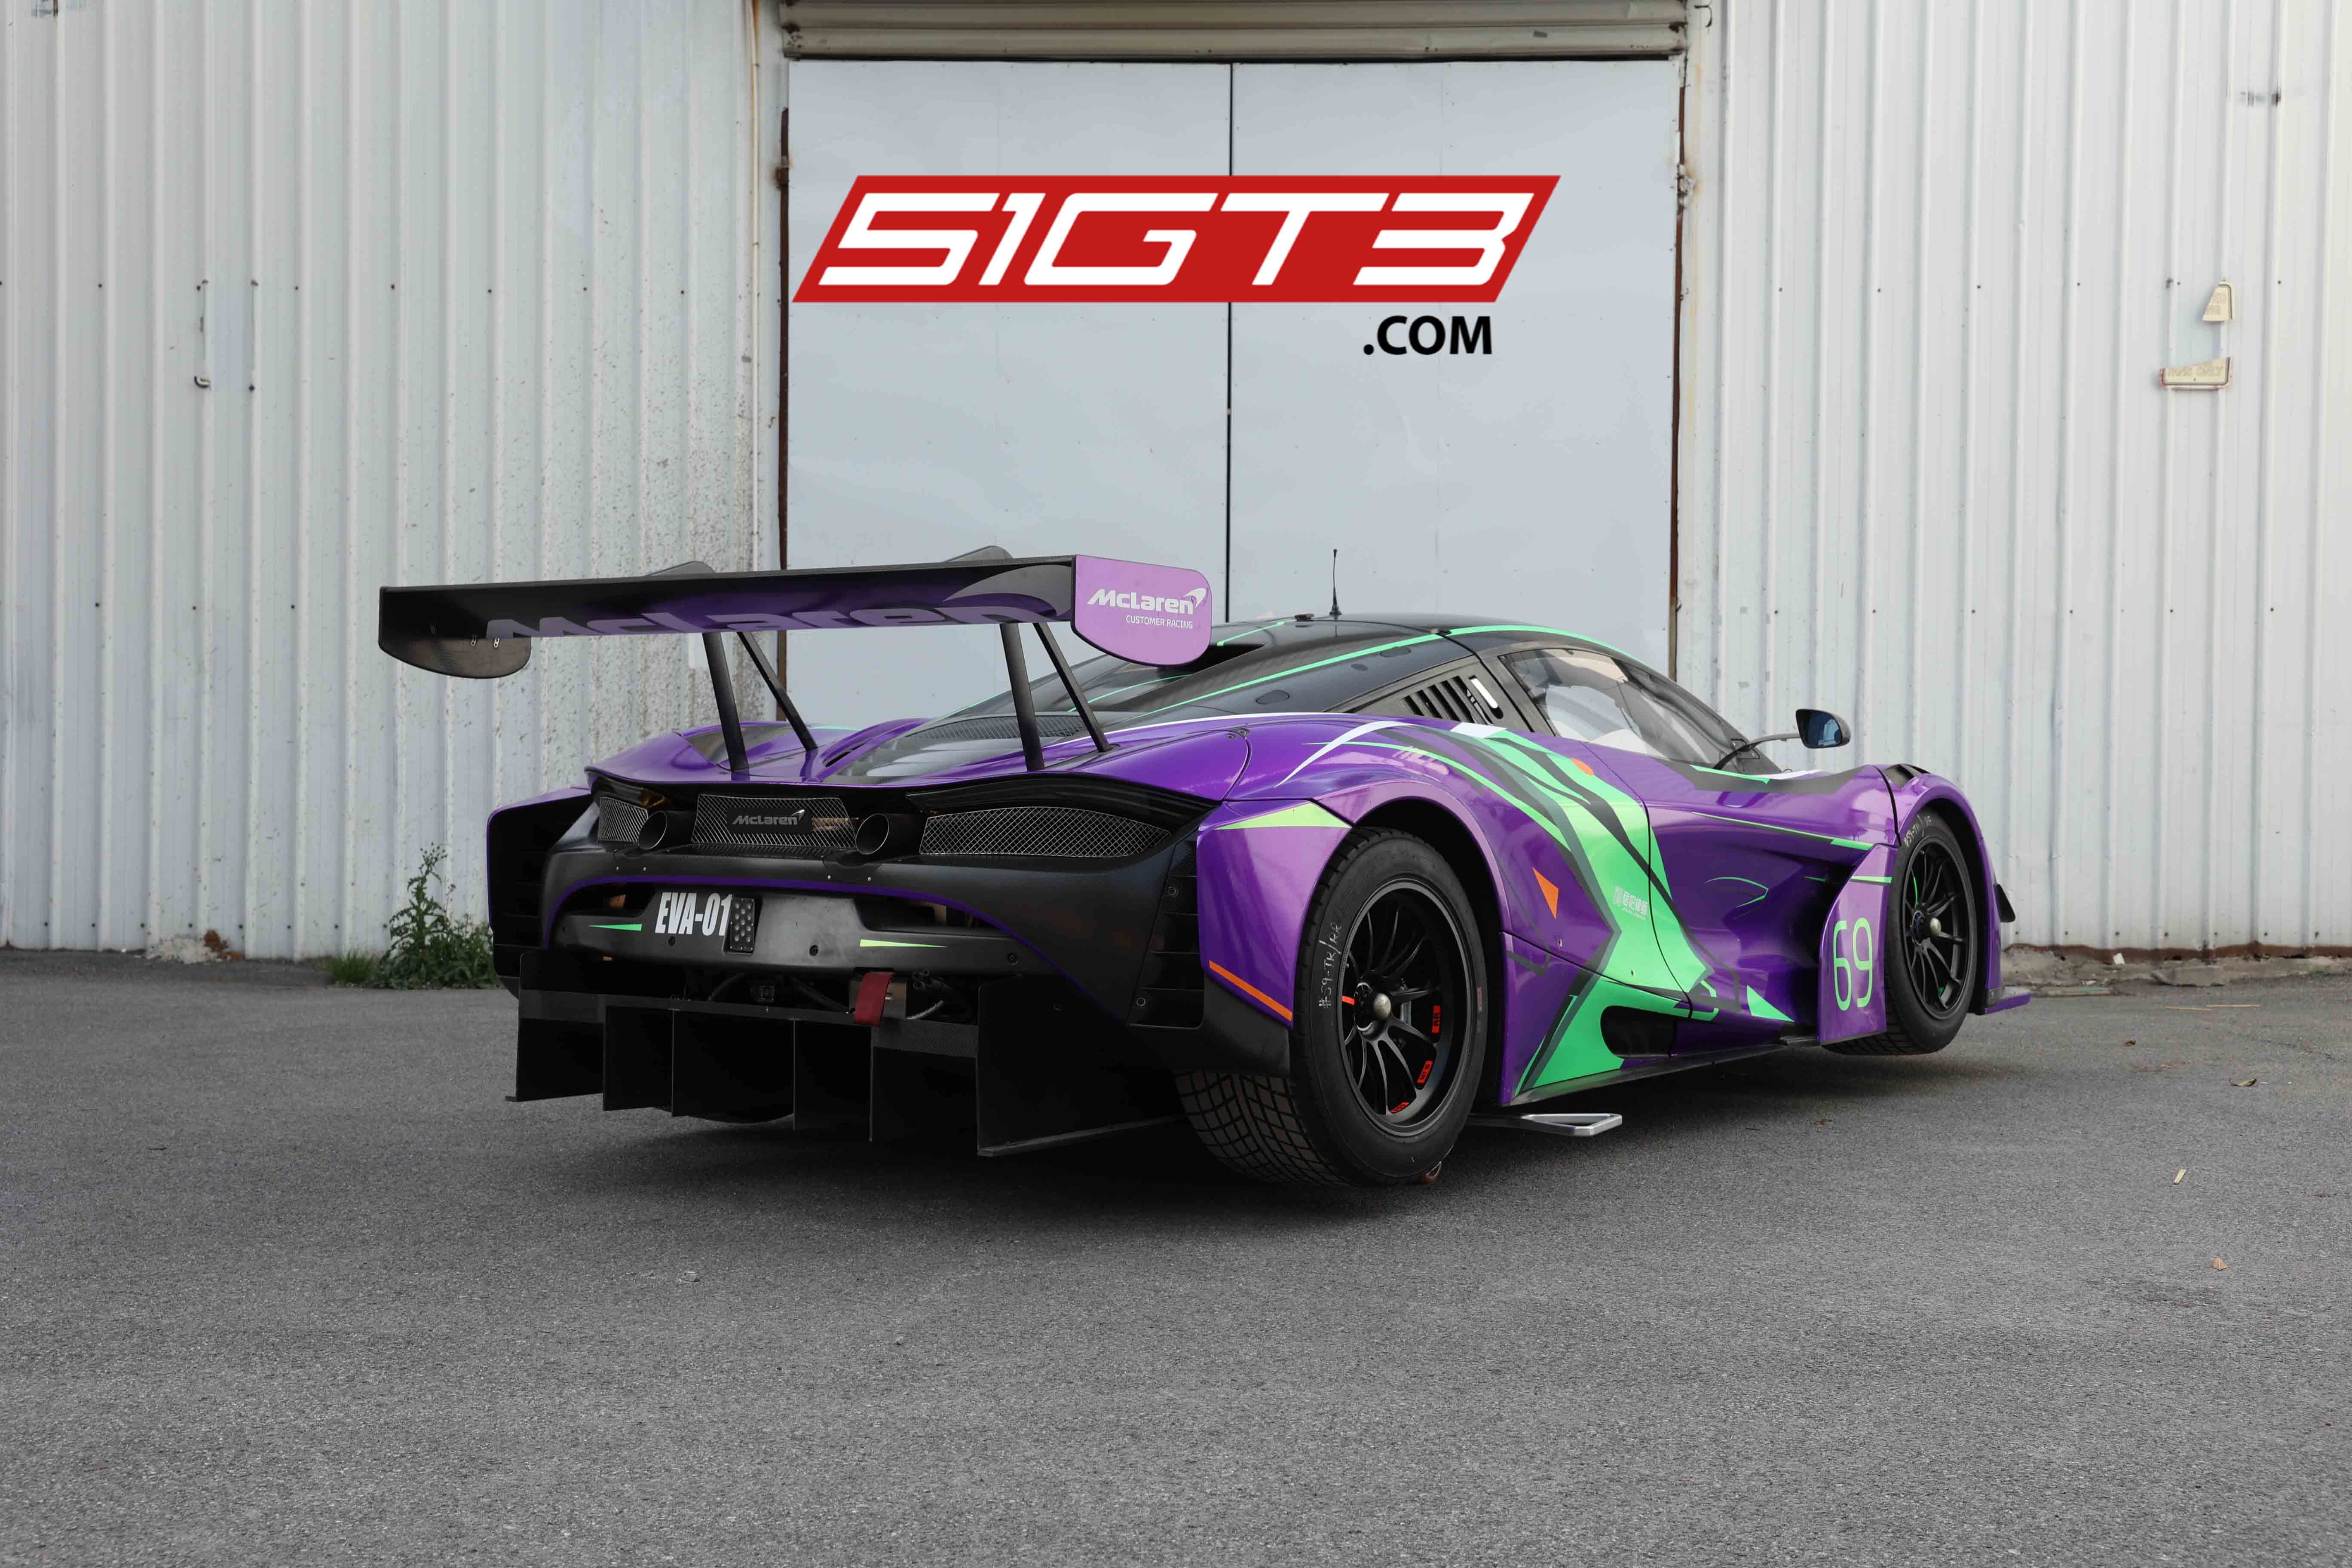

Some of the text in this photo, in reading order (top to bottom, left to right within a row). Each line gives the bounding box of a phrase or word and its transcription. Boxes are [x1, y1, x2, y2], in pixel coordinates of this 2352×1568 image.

[1087, 588, 1194, 615] McLaren
[1126, 615, 1193, 629] CUSTOMER RACING
[732, 815, 798, 825] McLaren
[655, 892, 733, 937] EVA-01
[1833, 918, 1873, 1011] 69
